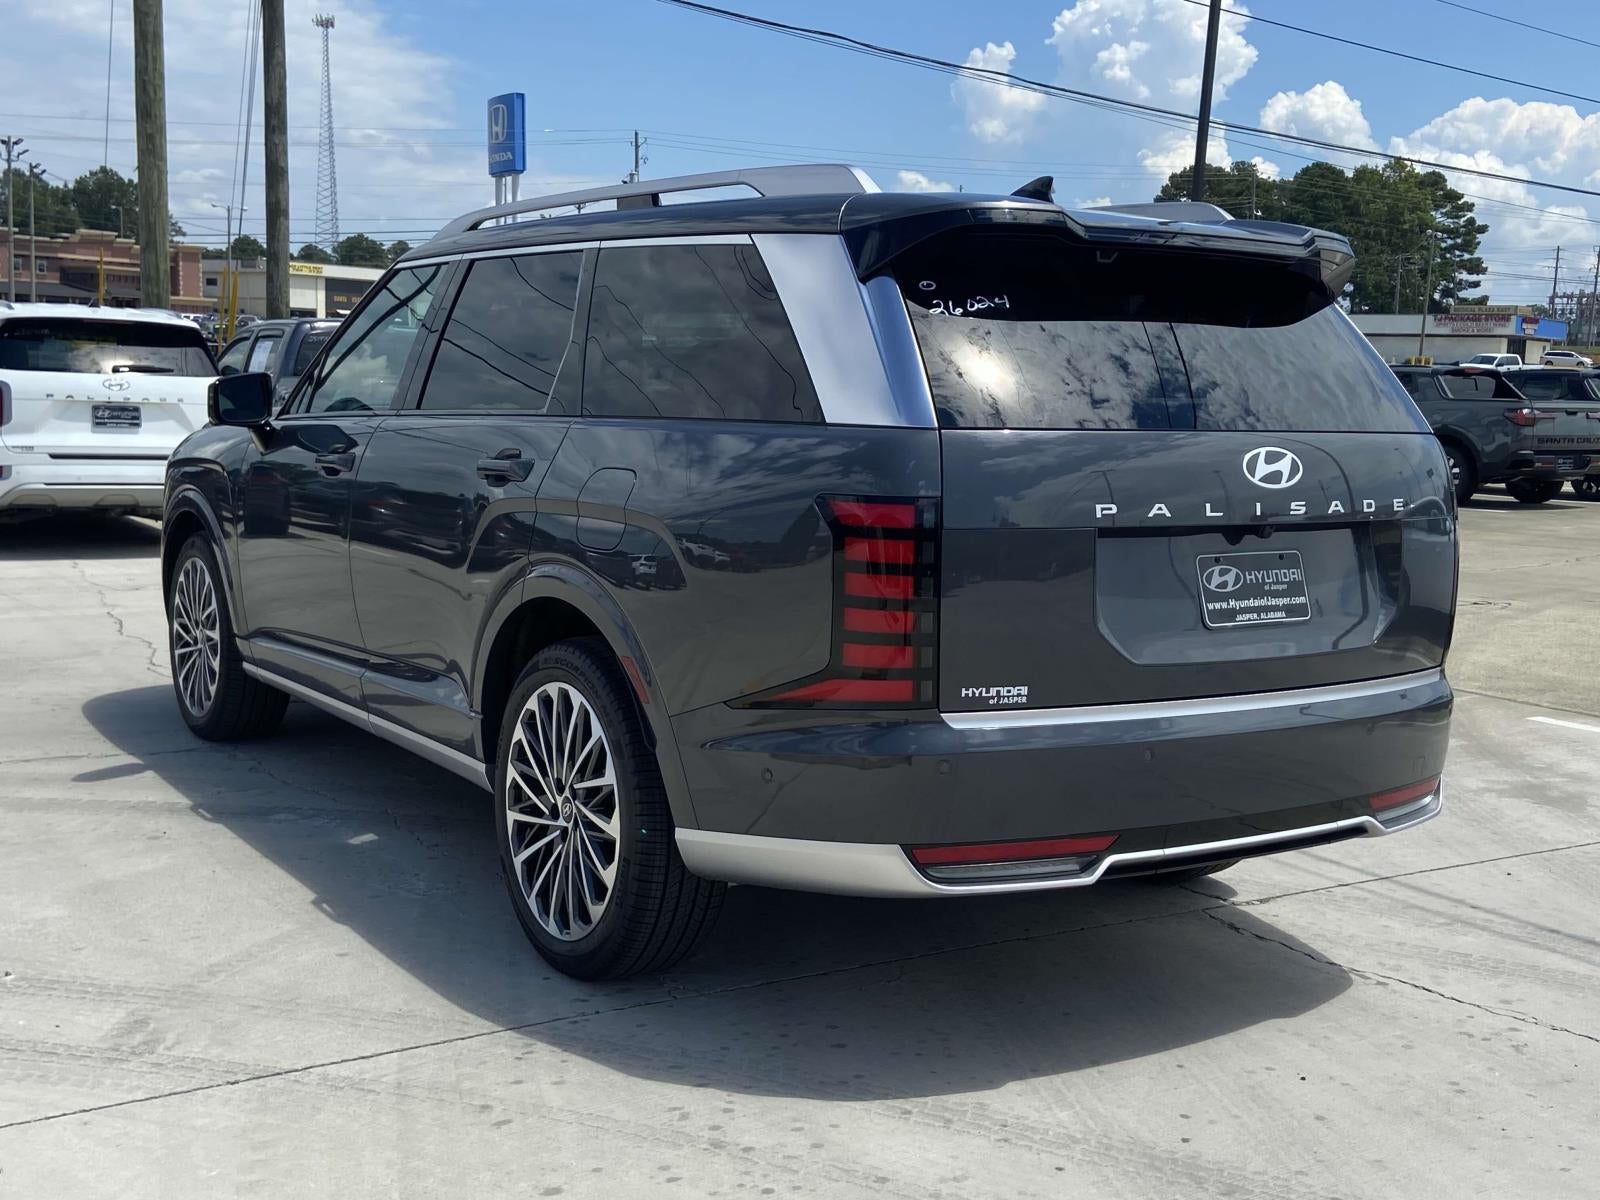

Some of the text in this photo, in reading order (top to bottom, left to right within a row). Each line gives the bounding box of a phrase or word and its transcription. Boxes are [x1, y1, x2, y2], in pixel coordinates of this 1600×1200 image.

[928, 294, 1010, 316] 26024
[1095, 498, 1405, 518] PALISADE
[1245, 568, 1303, 584] HYUNDAI
[1207, 595, 1306, 610] www.HyundaiofJasper.com
[1260, 611, 1286, 620] ALABAMA
[961, 686, 1028, 697] HYUNDAI
[999, 696, 1027, 704] JASPER
